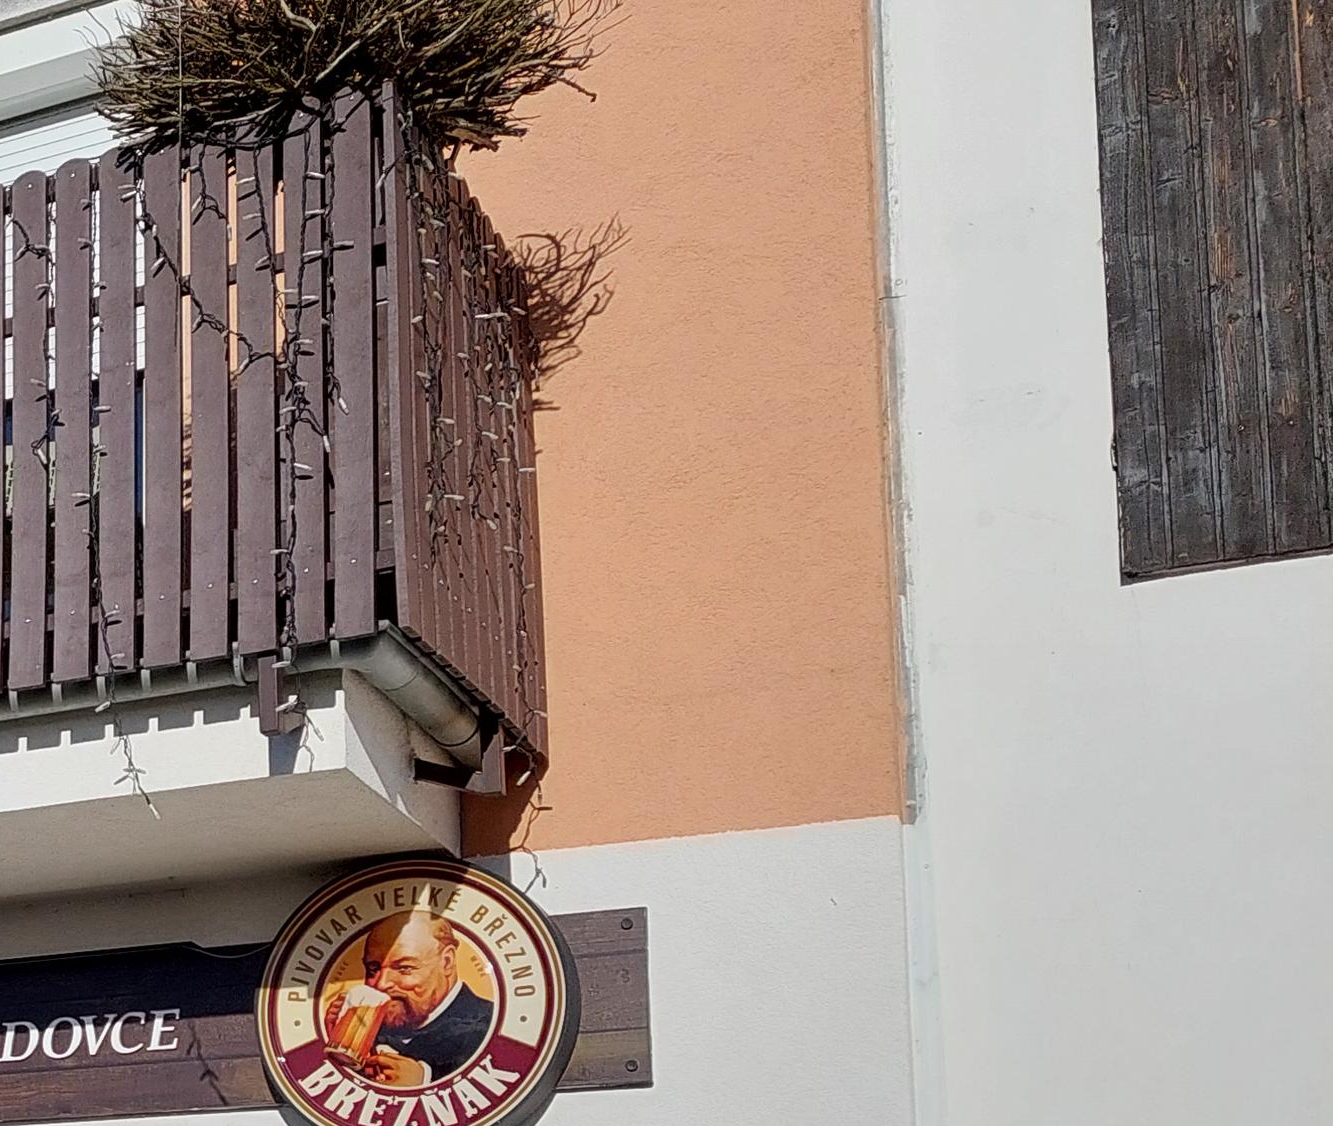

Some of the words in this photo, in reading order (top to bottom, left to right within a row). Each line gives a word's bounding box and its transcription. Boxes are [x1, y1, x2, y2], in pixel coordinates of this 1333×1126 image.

[287, 904, 364, 1003] PIVOVAR
[373, 885, 462, 913] VELKÉ
[469, 904, 537, 998] BŘEZNO
